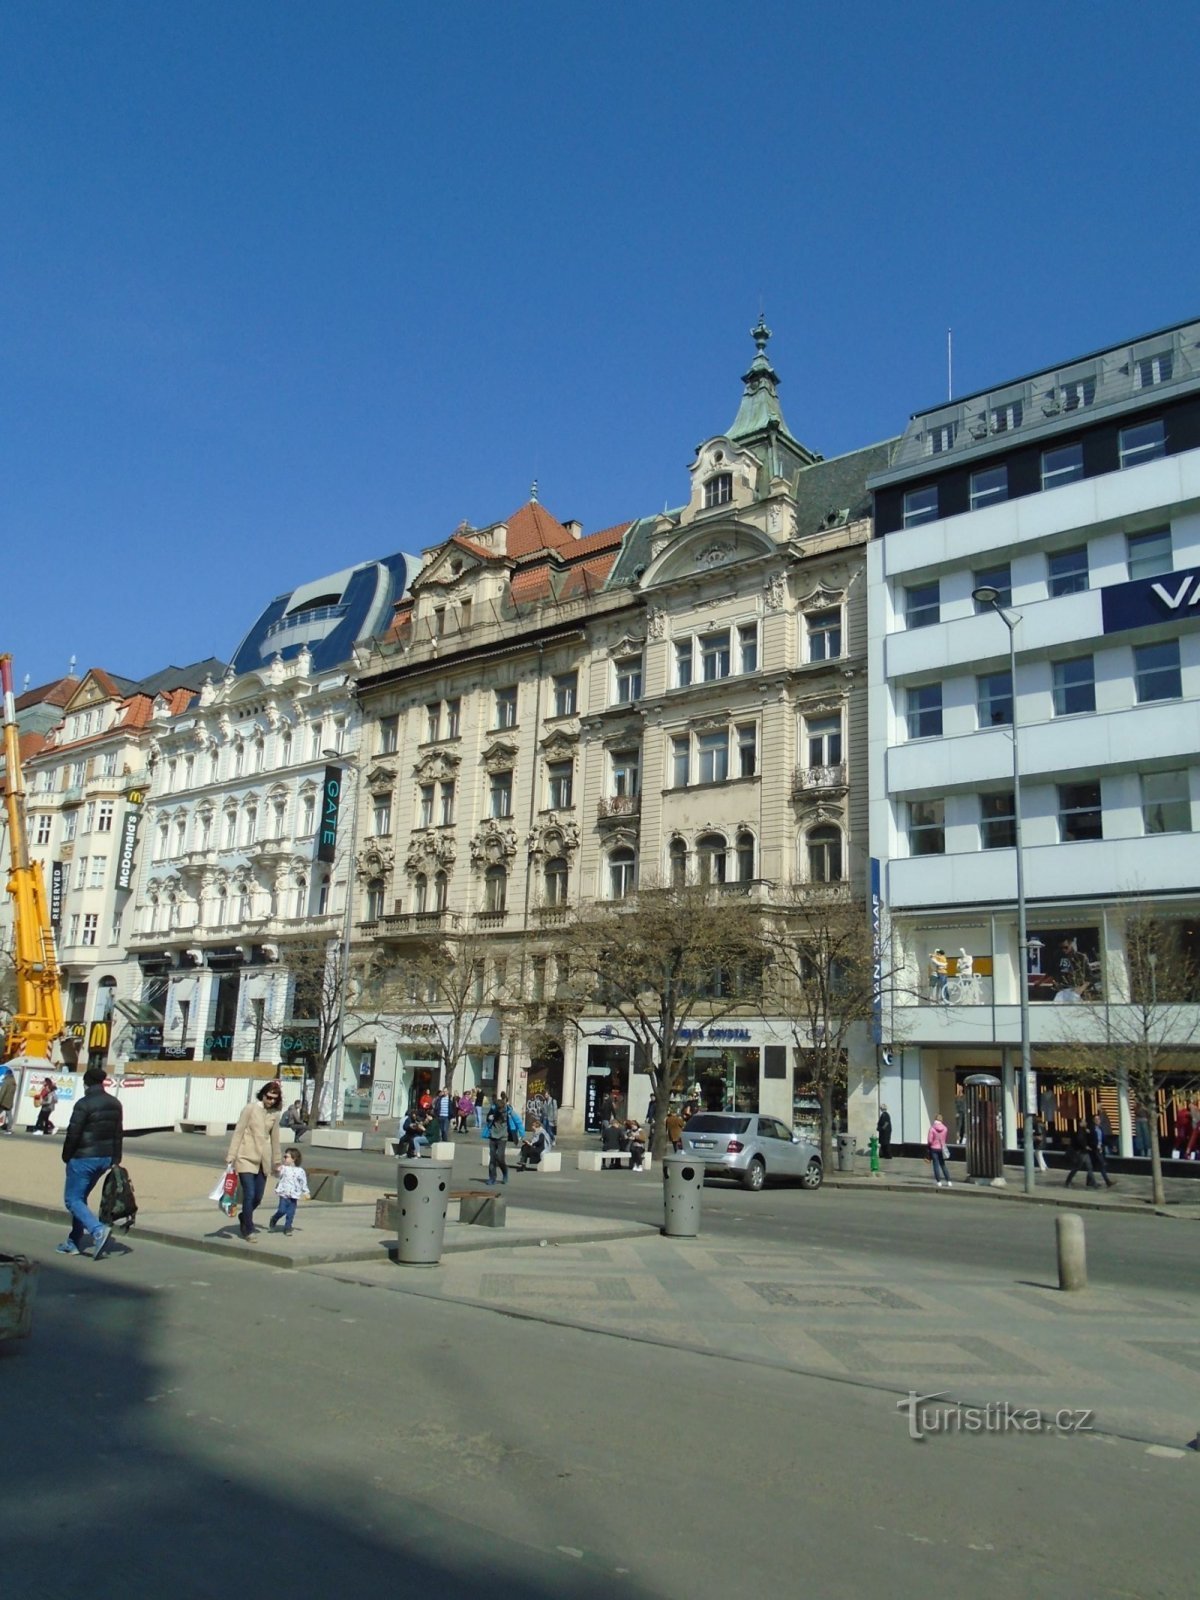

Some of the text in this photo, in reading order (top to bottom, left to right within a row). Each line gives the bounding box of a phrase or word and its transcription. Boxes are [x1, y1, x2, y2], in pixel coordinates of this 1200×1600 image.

[323, 780, 340, 846] GATE
[119, 815, 137, 888] McDonald's
[52, 869, 61, 920] RESERVED
